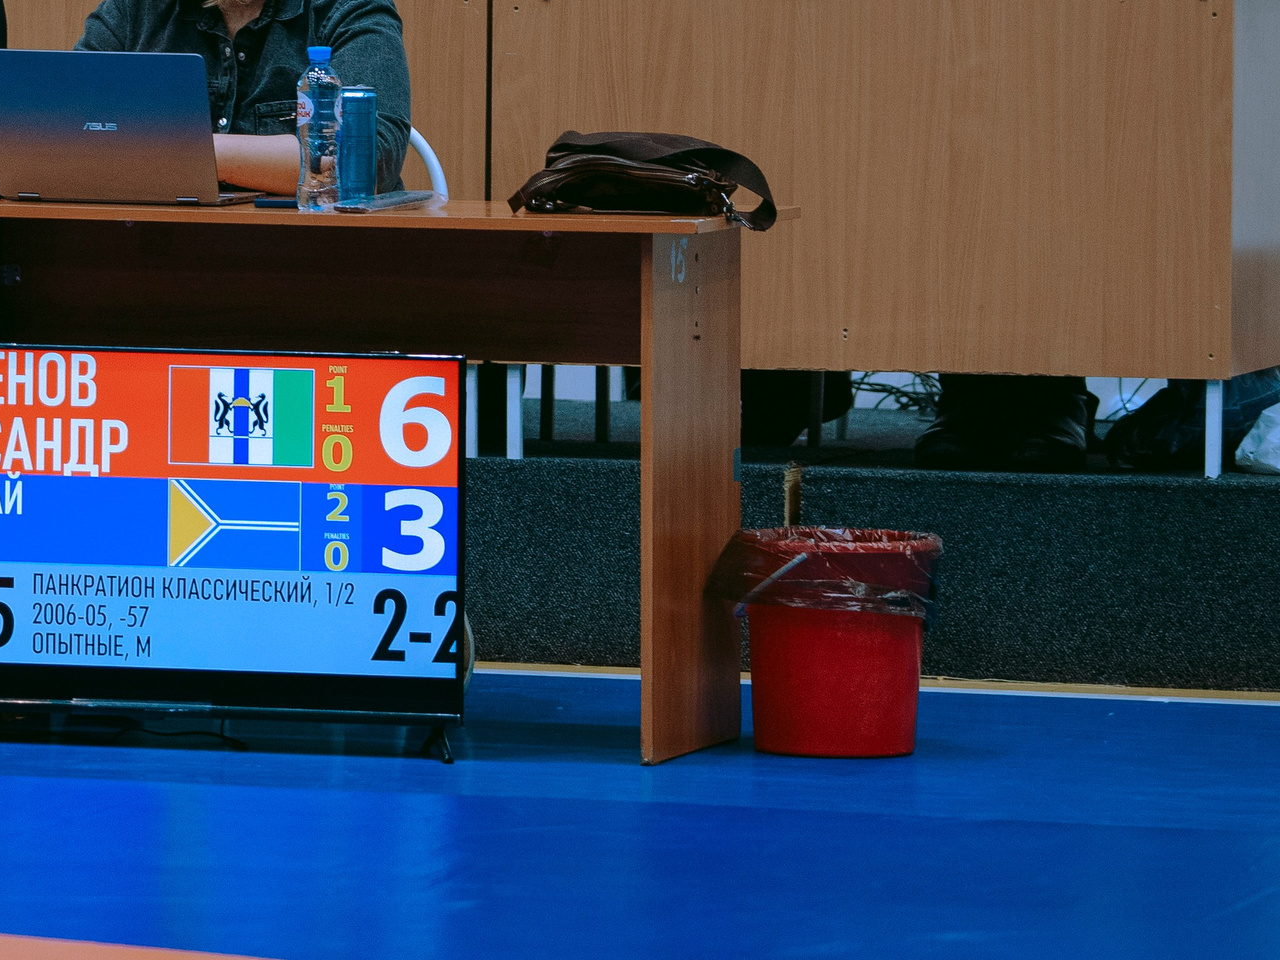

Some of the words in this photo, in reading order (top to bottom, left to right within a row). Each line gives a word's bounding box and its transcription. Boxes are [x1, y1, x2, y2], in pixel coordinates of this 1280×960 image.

[83, 122, 118, 130] ASUS
[329, 366, 348, 374] POINT
[326, 375, 352, 413] 1
[322, 424, 354, 433] PENALTIES
[379, 376, 452, 468] 6
[322, 434, 353, 472] 0
[325, 491, 350, 522] 2
[324, 532, 350, 540] PENALTIES
[382, 488, 446, 571] 3
[324, 541, 349, 572] 0
[32, 573, 155, 599] ПАНКРАТИОН
[162, 576, 319, 608] КЛАССИЧЕСКИЙ,
[325, 582, 355, 606] 1/2
[32, 602, 113, 630] 2006-05,
[119, 605, 150, 627] -57
[32, 632, 129, 661] ОПЫТНЫЕ,
[136, 635, 152, 658] М
